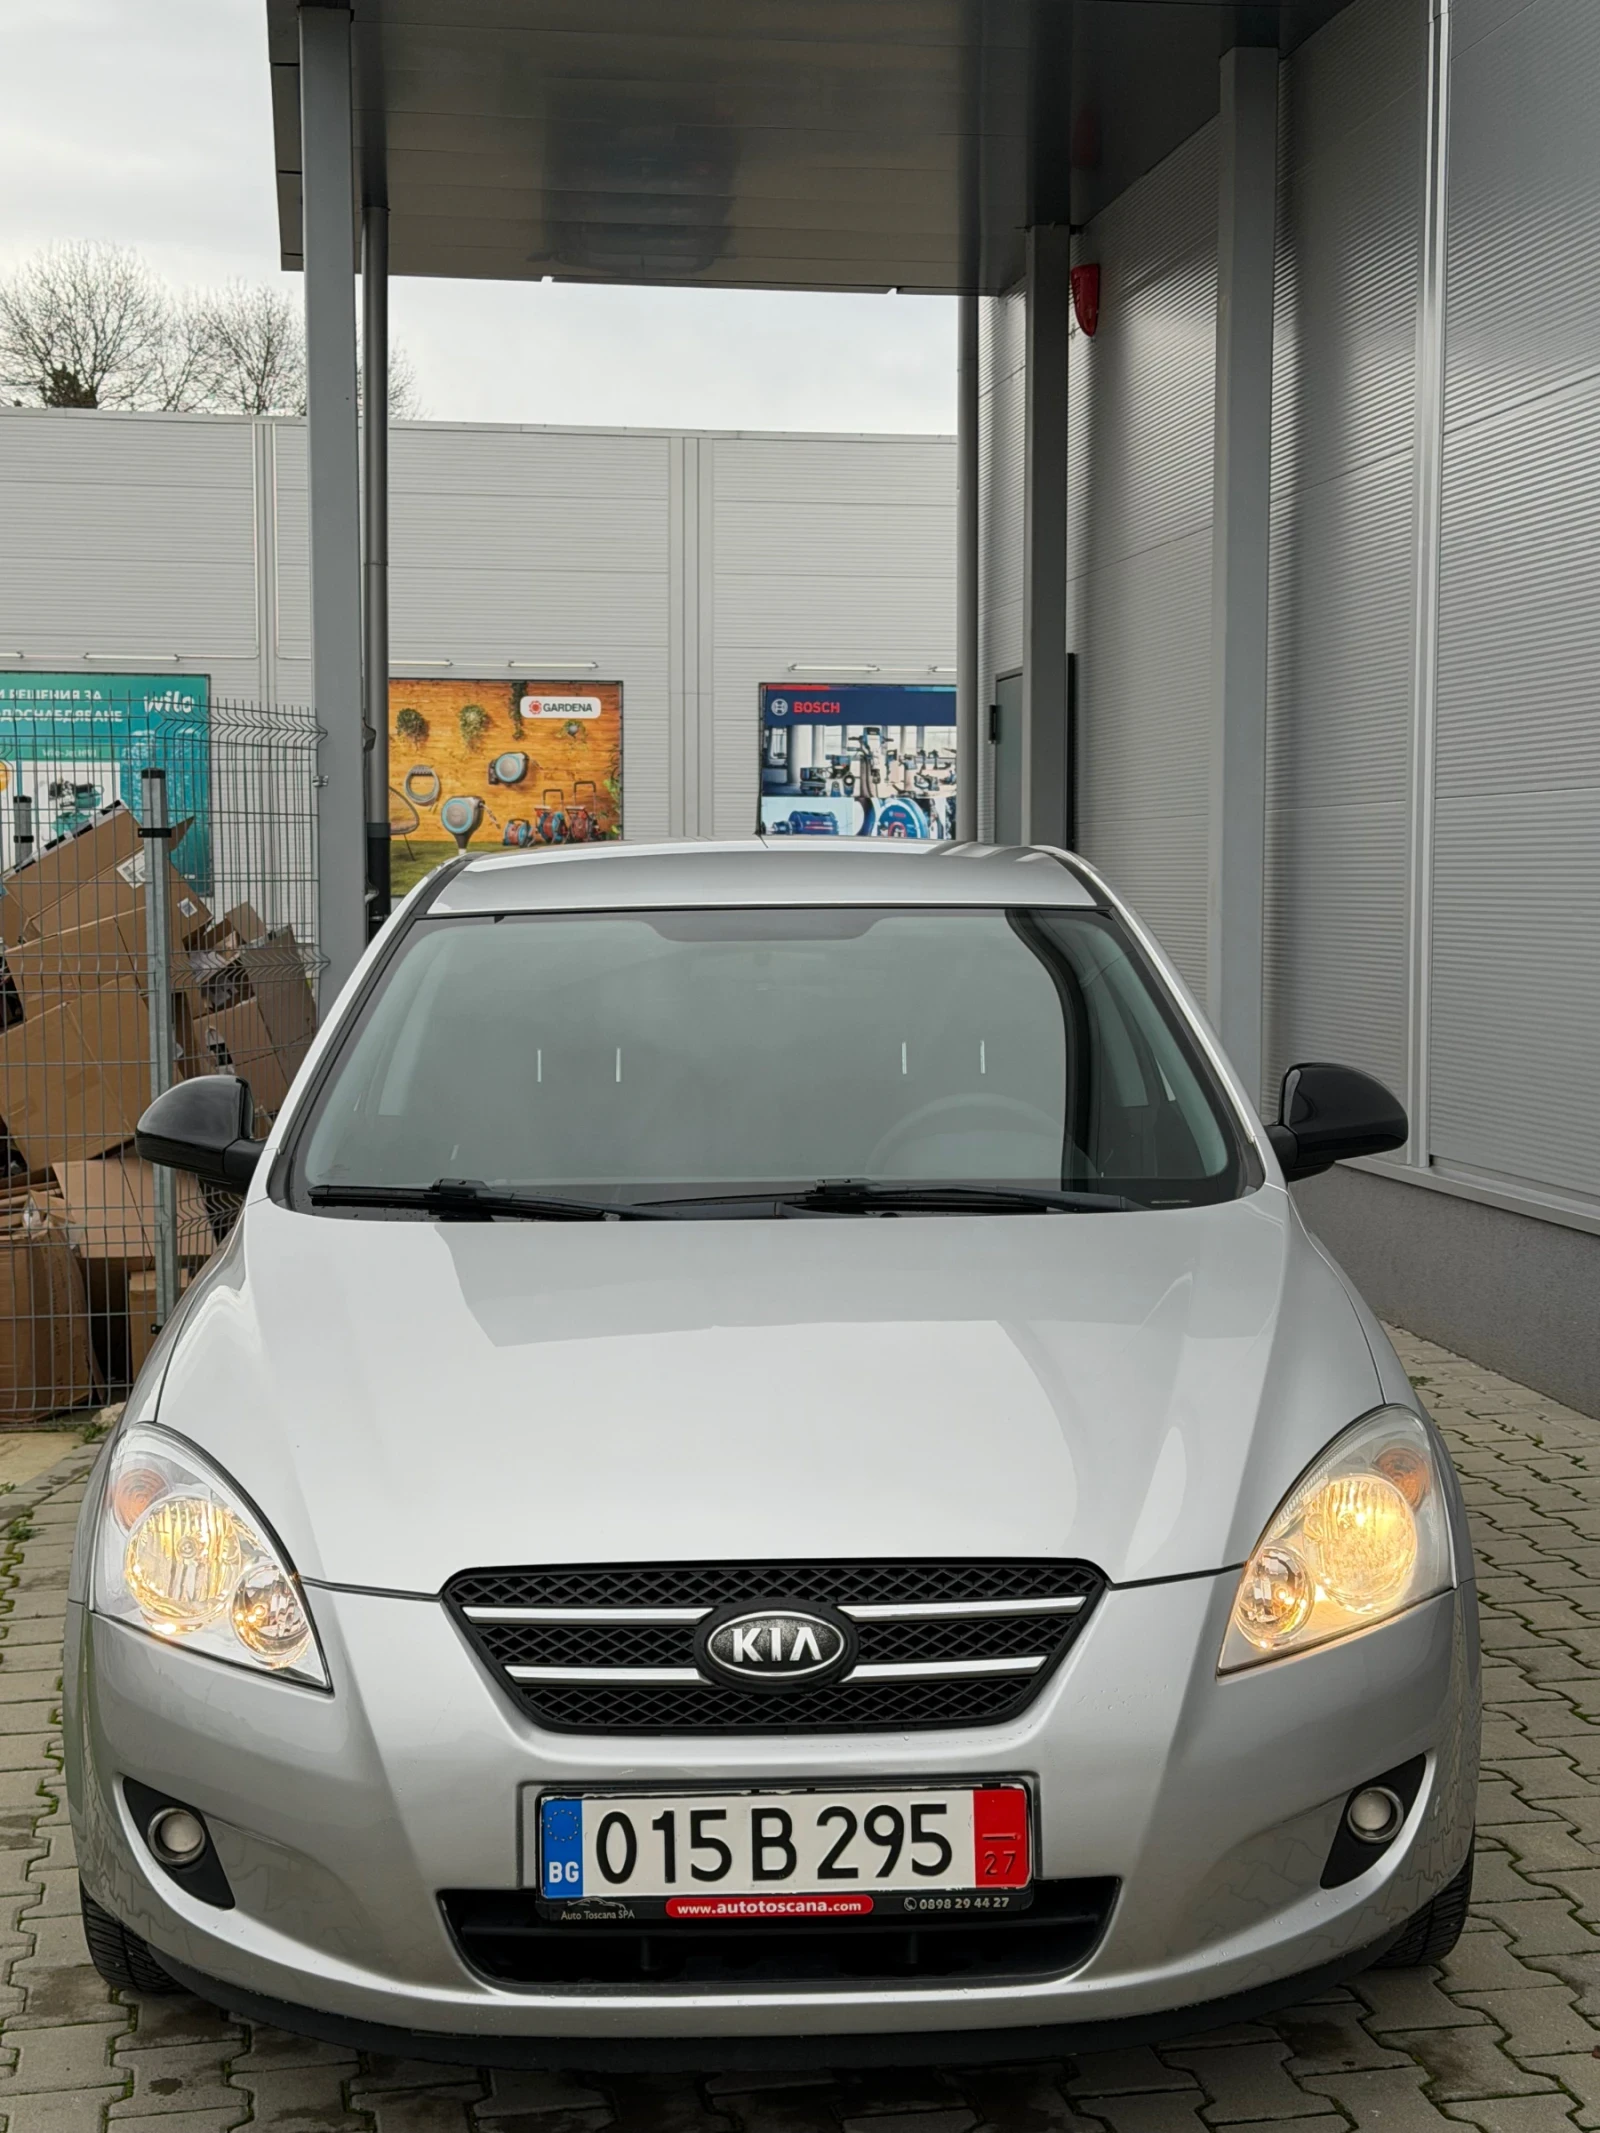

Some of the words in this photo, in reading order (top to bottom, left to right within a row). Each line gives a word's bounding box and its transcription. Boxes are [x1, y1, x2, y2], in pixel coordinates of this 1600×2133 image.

[9, 688, 80, 700] РЕШЕНИЯ
[83, 689, 102, 701] ЗА
[143, 690, 195, 713] wilo
[542, 702, 593, 713] GARDENA
[793, 701, 841, 713] BOSCH
[0, 708, 123, 722] ДОСНАБДЯВАНЕ
[731, 1626, 823, 1663] KIA
[548, 1861, 580, 1883] BG
[984, 1850, 1017, 1876] 27
[677, 1897, 862, 1915] www.autotoscana.com
[919, 1898, 951, 1910] 0898
[954, 1898, 971, 1909] 29
[974, 1897, 990, 1908] 44
[992, 1896, 1010, 1908] 27
[560, 1910, 582, 1921] Auto
[583, 1909, 617, 1920] Toscana
[618, 1909, 635, 1920] SPA
